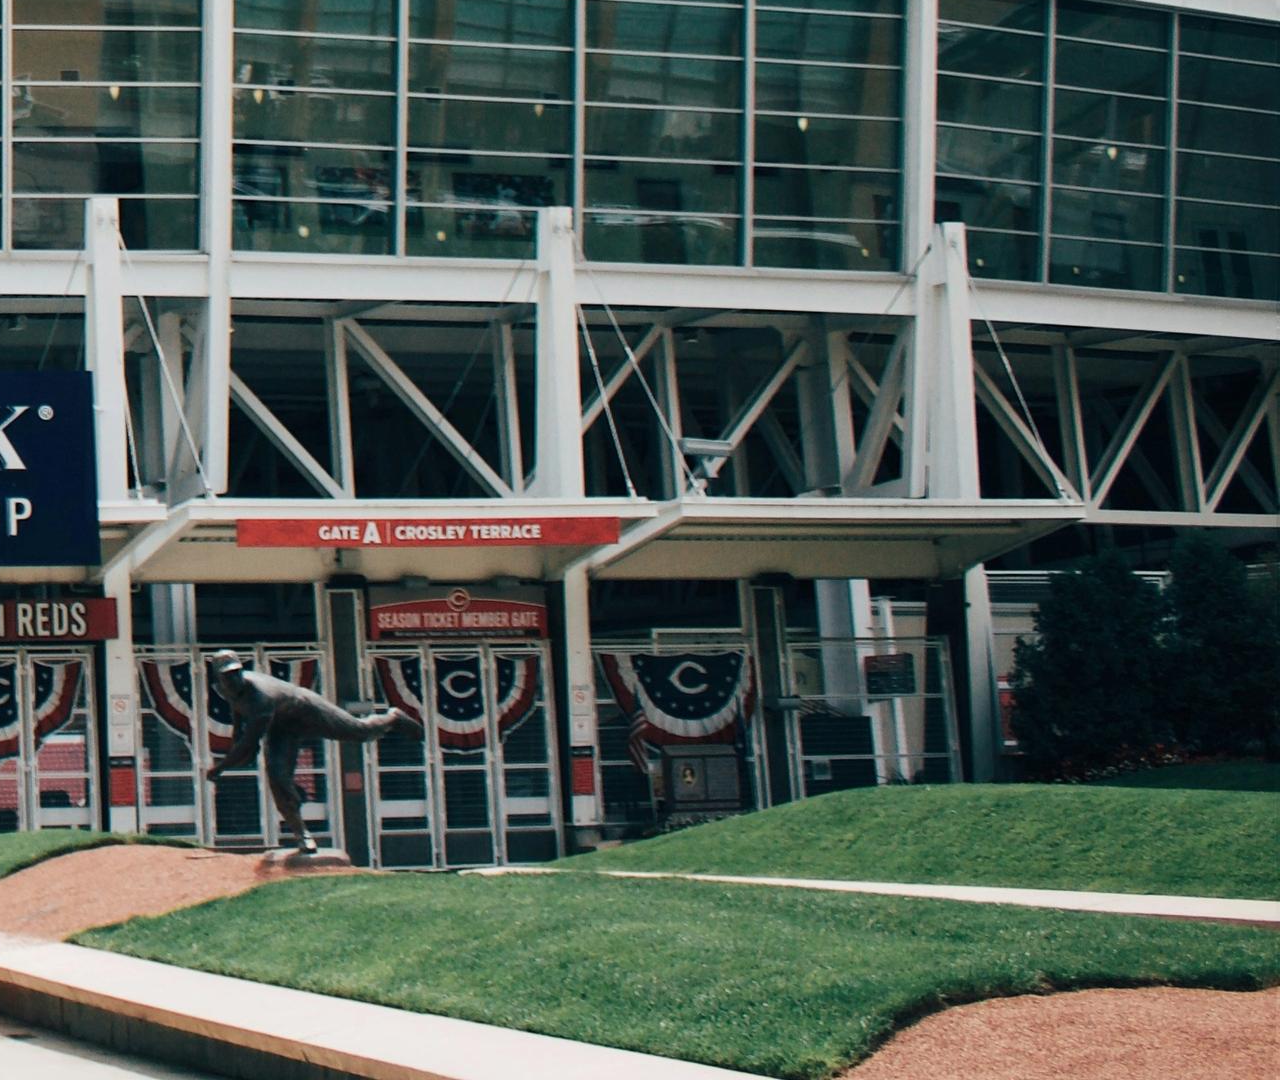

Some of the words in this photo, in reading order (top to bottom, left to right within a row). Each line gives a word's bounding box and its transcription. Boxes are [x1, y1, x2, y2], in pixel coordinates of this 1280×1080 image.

[318, 526, 360, 542] GATE
[363, 521, 382, 544] A
[394, 525, 468, 541] CROSLEY
[471, 523, 542, 540] TERRACE
[16, 603, 87, 638] REDS
[377, 612, 421, 629] SEASON
[423, 612, 459, 628] TICKET
[461, 612, 509, 628] MEMBER
[511, 611, 539, 627] GATE
